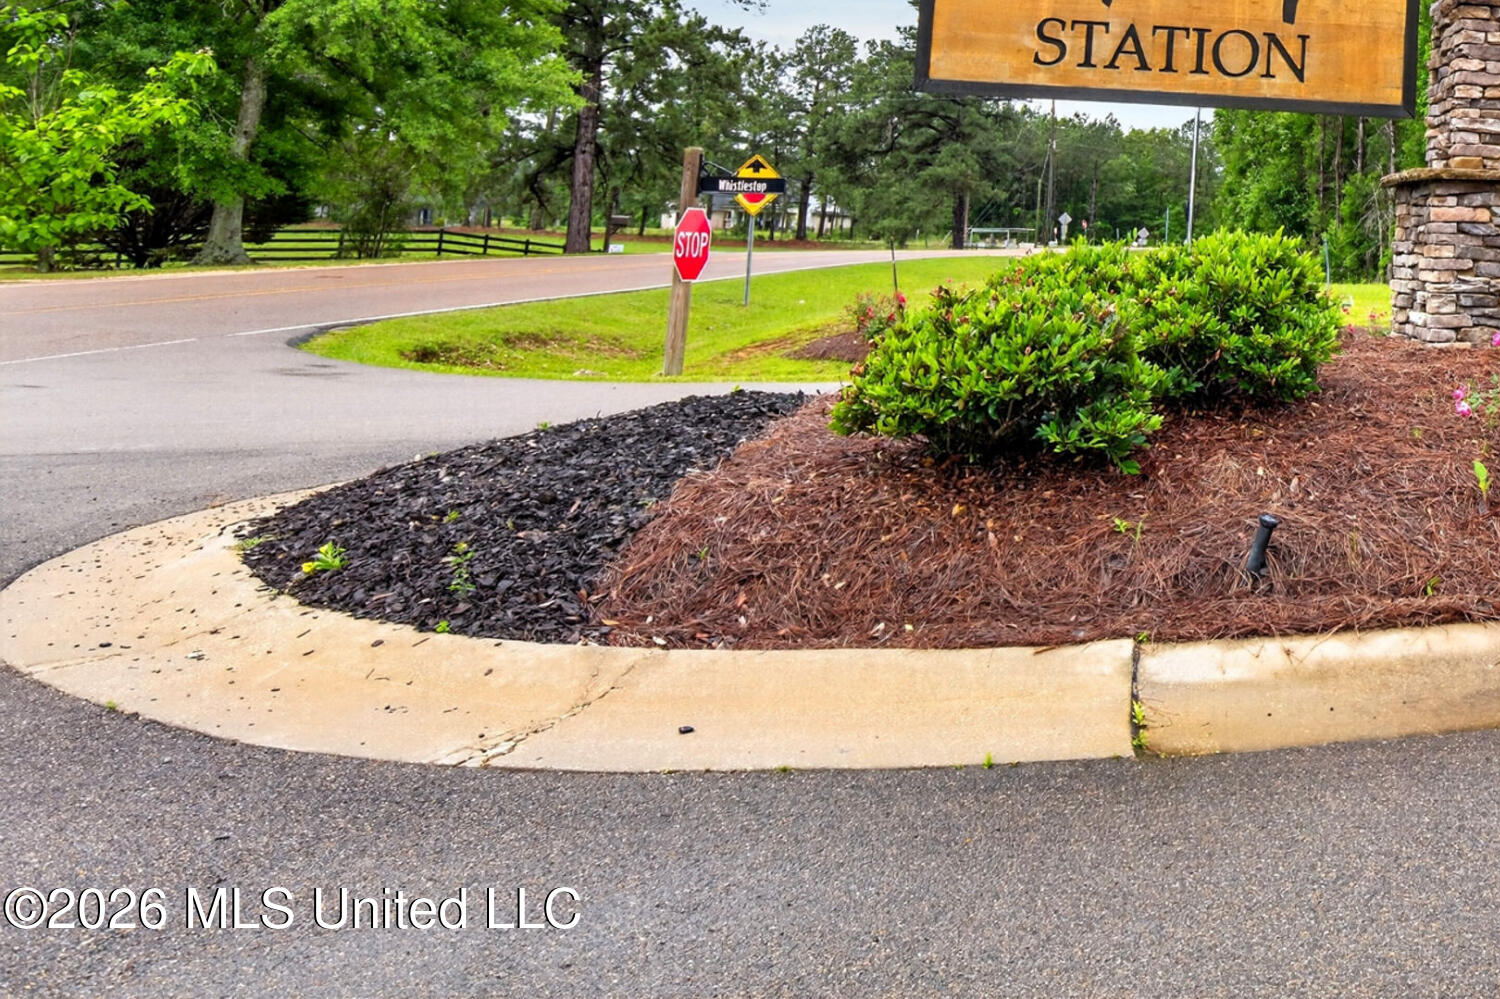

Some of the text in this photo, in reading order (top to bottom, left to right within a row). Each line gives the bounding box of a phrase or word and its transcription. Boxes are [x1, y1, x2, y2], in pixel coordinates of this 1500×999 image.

[1033, 17, 1310, 84] STATION
[718, 180, 767, 192] Whistlestop
[676, 232, 708, 257] STOP
